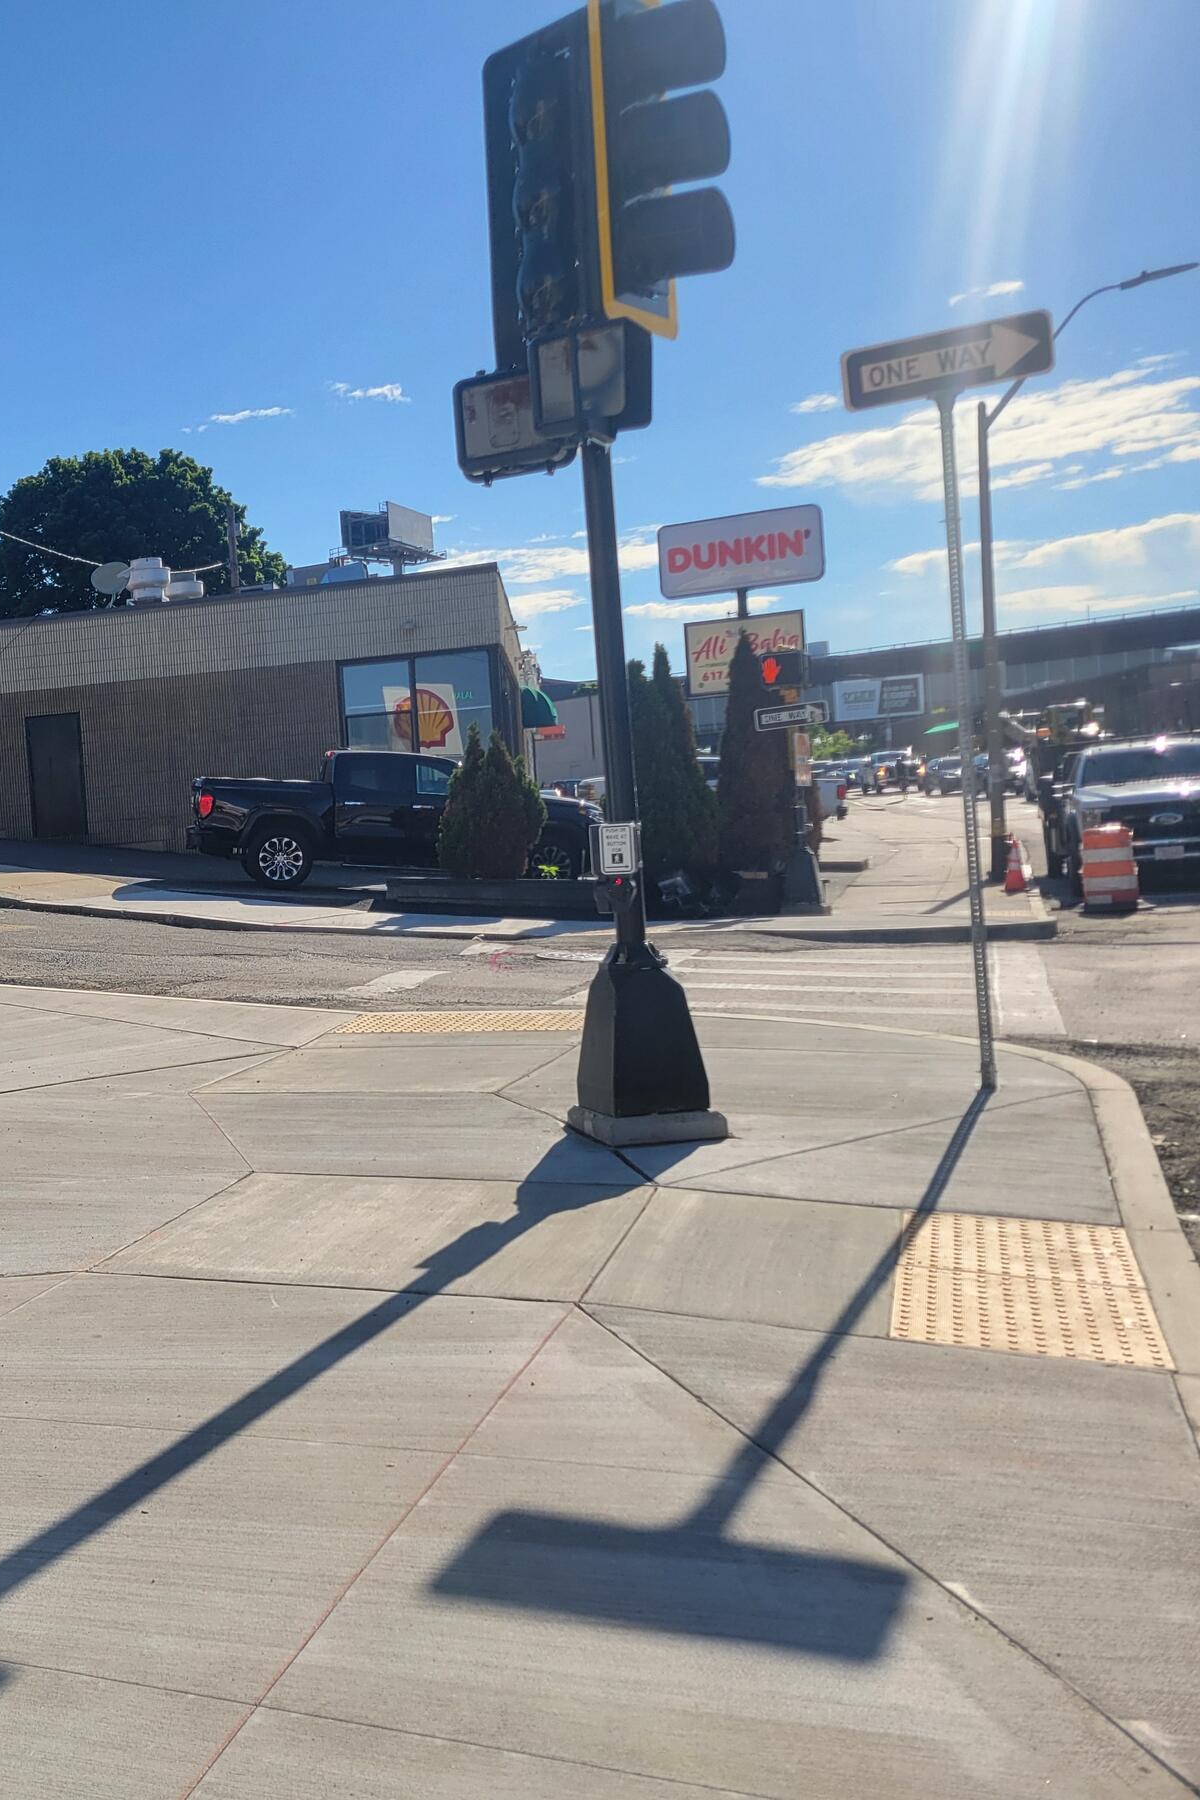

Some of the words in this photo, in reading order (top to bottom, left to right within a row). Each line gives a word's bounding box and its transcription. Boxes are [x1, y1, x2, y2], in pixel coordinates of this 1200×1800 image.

[868, 357, 921, 387] ONE
[937, 341, 991, 373] WAY
[667, 528, 811, 574] DUNKIN'
[691, 635, 728, 663] Ali
[763, 713, 782, 724] ONE
[788, 709, 807, 721] WAY
